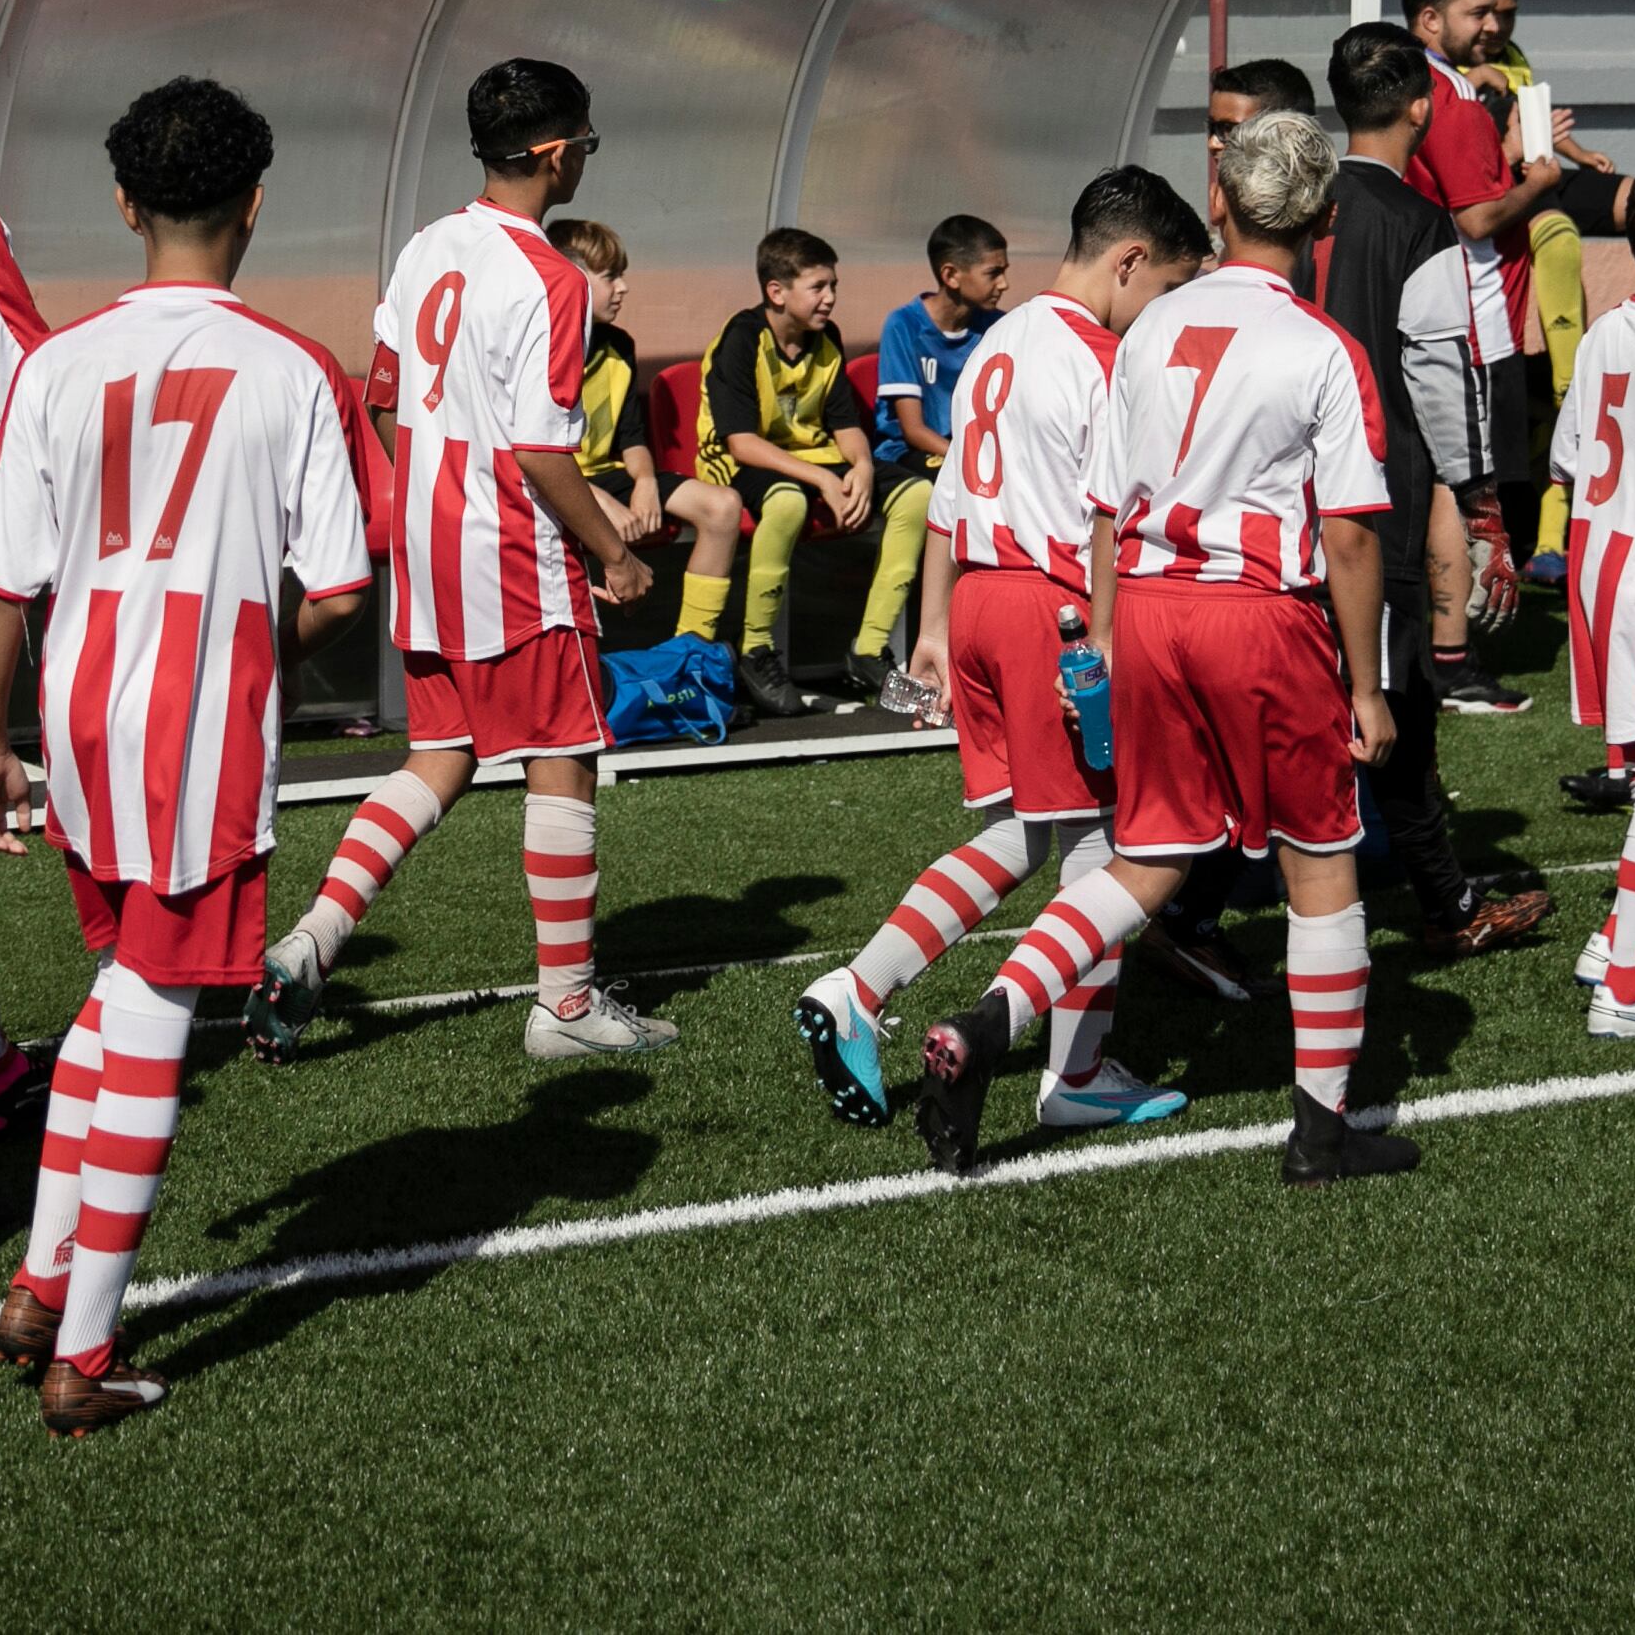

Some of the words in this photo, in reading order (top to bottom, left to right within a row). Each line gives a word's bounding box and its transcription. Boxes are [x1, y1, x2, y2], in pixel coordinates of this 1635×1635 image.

[416, 271, 466, 414] 9
[920, 355, 938, 385] 10
[1166, 326, 1238, 478] 7
[99, 368, 237, 562] 17
[962, 352, 1014, 499] 8
[1585, 373, 1630, 507] 5
